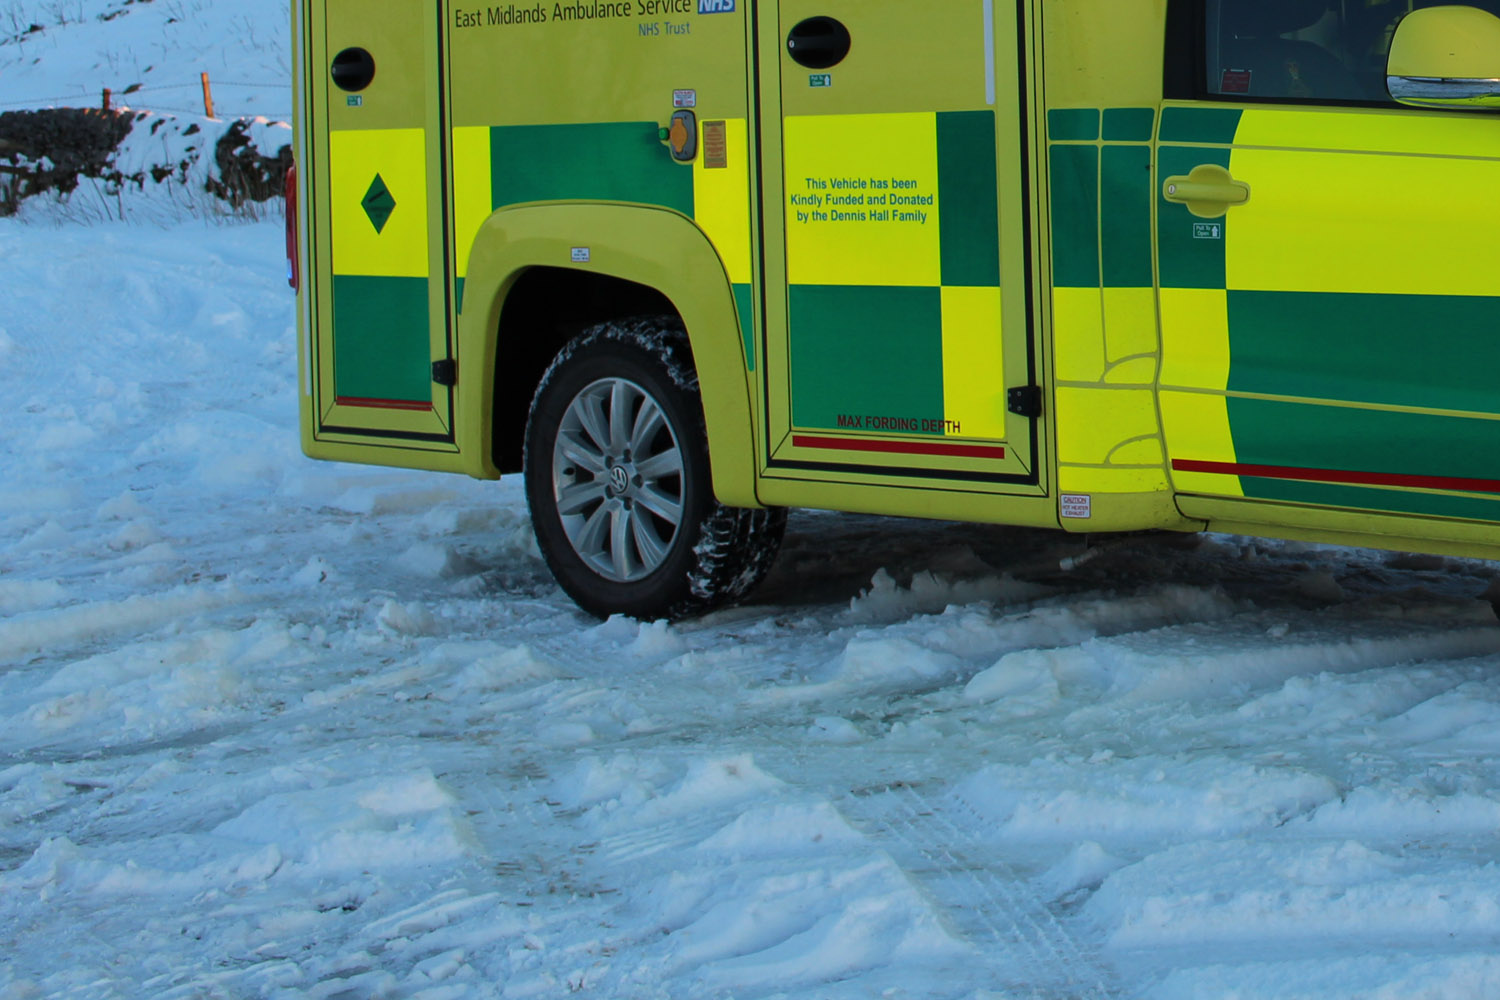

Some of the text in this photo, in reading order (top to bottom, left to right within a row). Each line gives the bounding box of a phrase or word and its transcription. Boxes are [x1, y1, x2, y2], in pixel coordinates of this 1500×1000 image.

[455, 9, 482, 28] East
[487, 3, 547, 26] Midlands
[552, 0, 632, 22] Ambulance
[638, 21, 690, 37] NHS Trust
[805, 177, 917, 189] This Vehicle has been
[791, 193, 934, 208] Kindly Funded and Donated
[797, 209, 927, 224] by the Dennis Hall Family
[837, 414, 961, 434] MAX FORDING DEPTH
